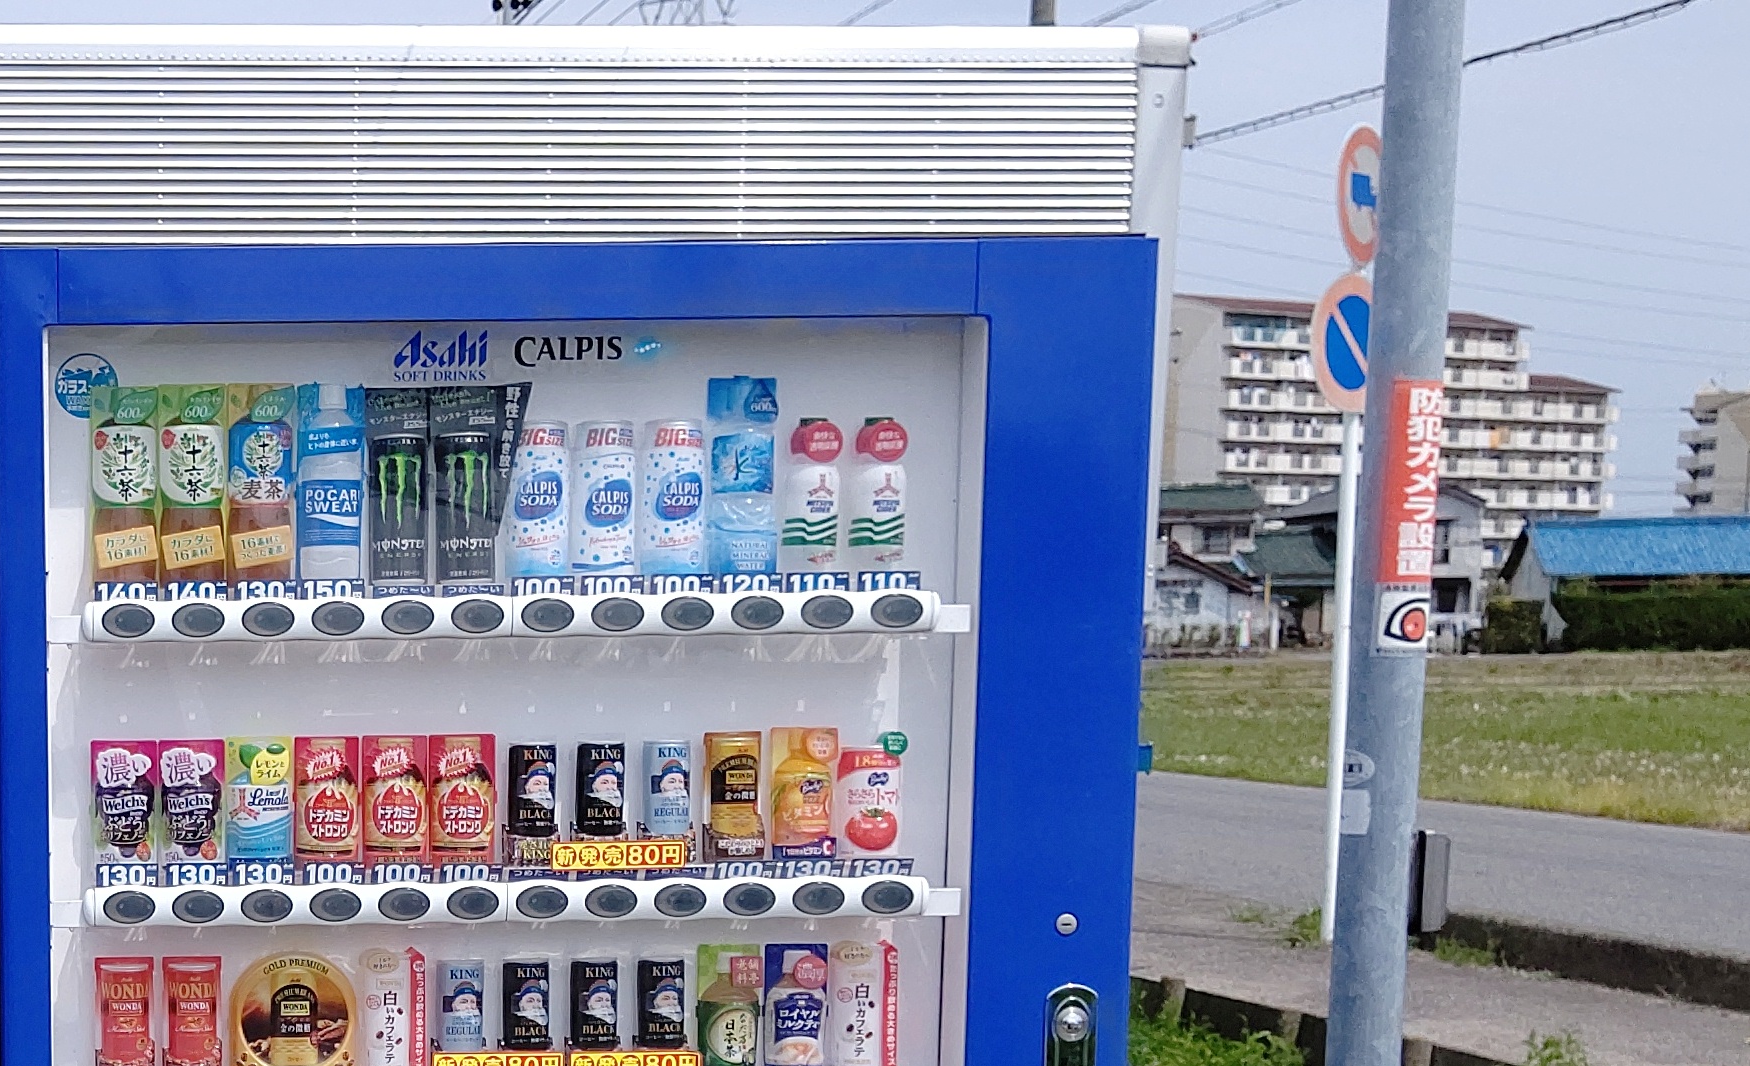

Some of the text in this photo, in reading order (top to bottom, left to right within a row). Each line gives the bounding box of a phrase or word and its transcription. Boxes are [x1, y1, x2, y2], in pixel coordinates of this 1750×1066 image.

[394, 330, 488, 369] Asahi
[514, 336, 622, 367] CALPIS
[394, 370, 486, 382] SOFT DRINKS
[369, 413, 427, 426] モンスターエナジー
[586, 428, 619, 448] BIG
[117, 446, 139, 502] 十六茶
[1396, 386, 1444, 576] 防犯カメラ設置
[241, 479, 283, 500] 麦茶
[305, 488, 361, 500] POCARI
[520, 481, 558, 495] CALPIS
[520, 494, 558, 507] SODA
[591, 490, 629, 505] CALPIS
[305, 502, 358, 513] SWEAT
[105, 534, 146, 550] カラダに
[731, 541, 769, 549] NATURAL
[732, 551, 769, 559] MINERAL
[736, 562, 765, 570] WATER
[524, 749, 553, 761] KING
[591, 748, 621, 760] KING
[658, 747, 687, 758] KING
[103, 753, 147, 784] 濃い
[256, 759, 285, 769] レモンと
[313, 754, 337, 770] No.1
[256, 769, 281, 778] ライム
[104, 796, 147, 814] Welch's
[168, 794, 211, 812] Welch's
[309, 809, 350, 823] ドデカミン
[378, 806, 418, 820] ドデカミン
[311, 824, 348, 838] ストロング
[556, 845, 680, 866] 新発売 80円
[263, 958, 330, 976] GOLD PREMIUM
[112, 1002, 143, 1012] WONDA
[179, 1002, 210, 1011] WONDA
[779, 1009, 819, 1018] ロイヤル
[383, 990, 398, 1064] 白いカフェラテ
[855, 982, 870, 1058] 白いカフェラテ
